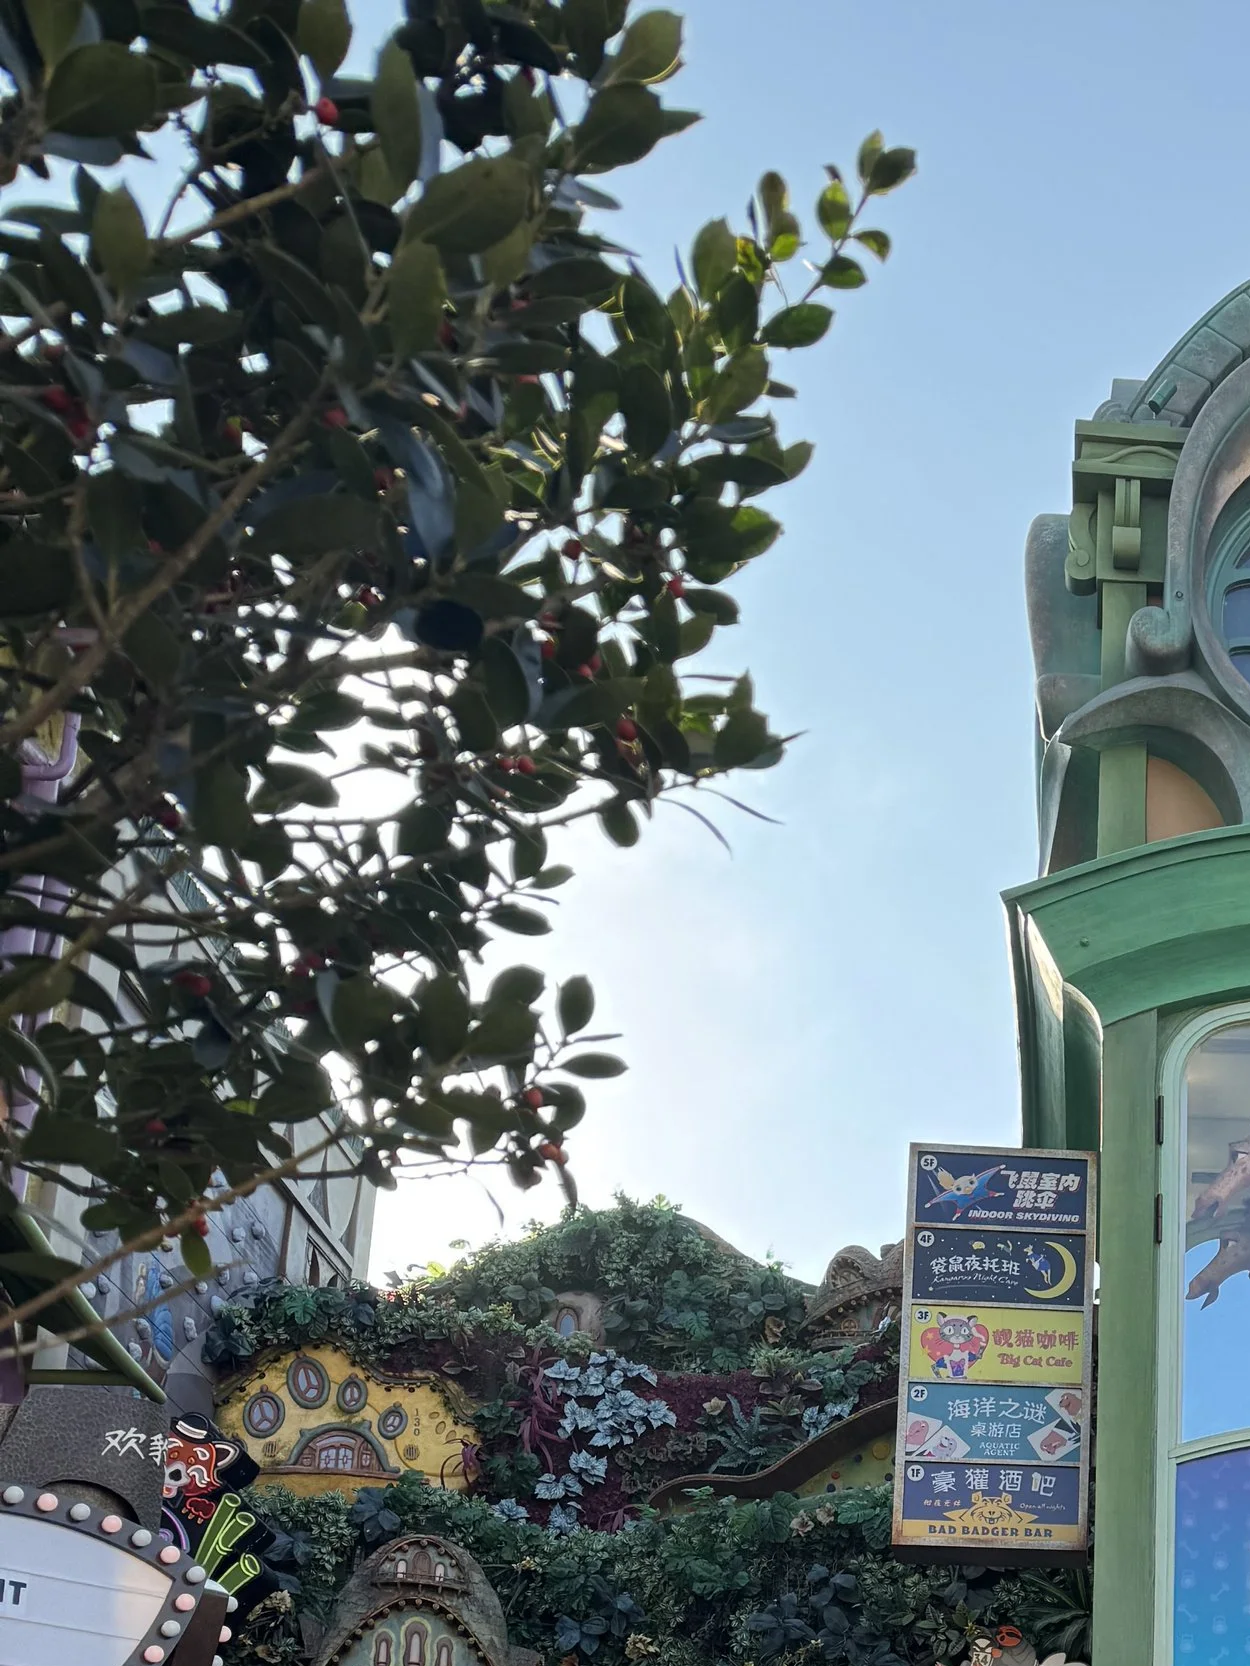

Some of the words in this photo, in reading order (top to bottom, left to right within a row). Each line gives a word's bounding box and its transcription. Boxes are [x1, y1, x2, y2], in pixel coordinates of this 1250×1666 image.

[922, 1158, 936, 1168] 5F
[1000, 1169, 1082, 1192] 飞鼠室内
[1012, 1190, 1057, 1209] 跳伞
[967, 1209, 1013, 1220] INDOOR
[1015, 1212, 1080, 1223] SKYDIVING
[919, 1233, 933, 1244] 4F
[929, 1254, 1021, 1276] 袋鼠夜托班
[917, 1311, 930, 1320] 3F
[997, 1353, 1021, 1367] Big
[1023, 1355, 1044, 1368] Cat
[1048, 1356, 1073, 1368] Cafe
[913, 1389, 926, 1398] 2F
[947, 1396, 1047, 1424] 海洋之谜
[970, 1421, 1022, 1439] 桌游店
[979, 1441, 1021, 1451] AQUATIC
[983, 1449, 1016, 1457] AGENT
[909, 1468, 922, 1478] 1F
[930, 1468, 1057, 1497] 豪獾酒吧
[928, 1525, 957, 1535] BAD
[961, 1525, 1019, 1537] BADGER
[1021, 1527, 1054, 1538] BAR
